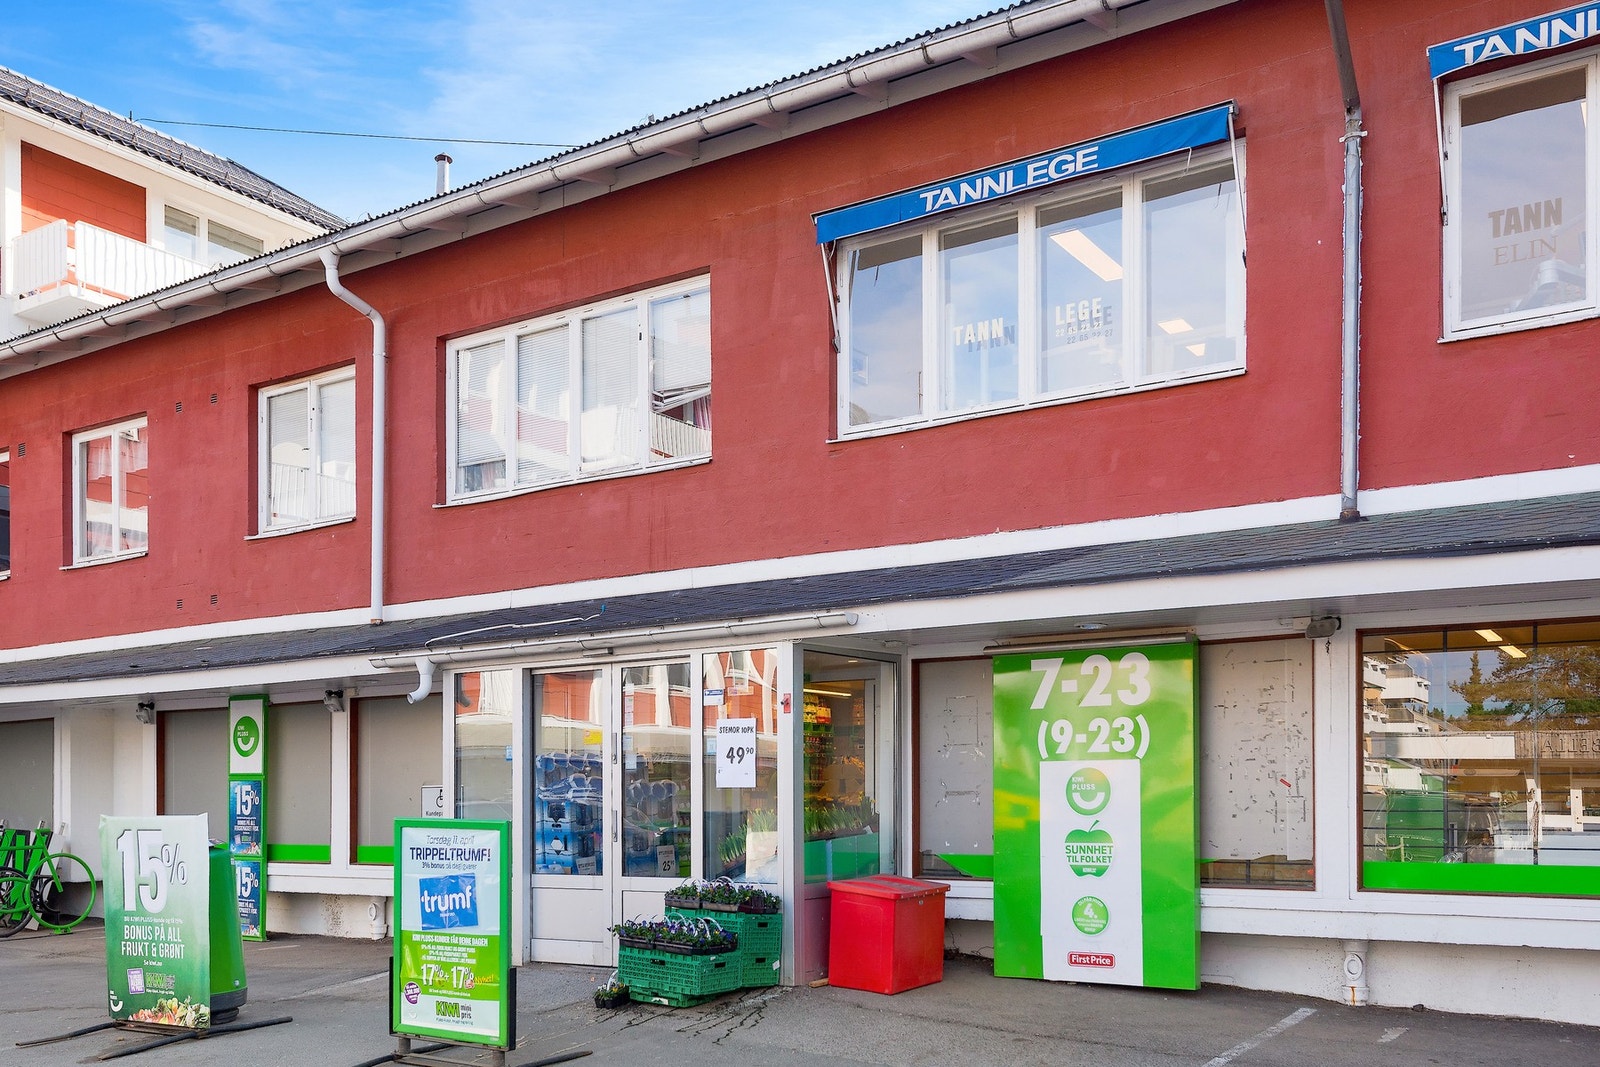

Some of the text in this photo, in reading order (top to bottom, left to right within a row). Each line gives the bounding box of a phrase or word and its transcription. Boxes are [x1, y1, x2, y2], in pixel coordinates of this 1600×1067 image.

[919, 146, 1099, 212] TANNLEGE
[1488, 197, 1562, 239] TANN
[1493, 235, 1559, 266] ELIN
[1056, 298, 1102, 326] LEGE
[953, 318, 1004, 346] TANN
[1030, 652, 1151, 710] 7-23
[719, 726, 740, 734] STEMOR
[1038, 714, 1150, 760] (9-23)
[1072, 783, 1096, 791] PLUSS
[234, 784, 260, 816] 15%
[427, 835, 451, 846] Torsdag
[460, 835, 475, 847] april
[1065, 845, 1114, 855] SUNNHET
[409, 847, 491, 862] TRIPPELTRUMF!
[1067, 855, 1112, 864] TIL FOLKET
[116, 829, 189, 914] 15%
[421, 885, 472, 913] trumf
[124, 923, 182, 942] BONUS PÅ ALL
[121, 941, 185, 960] FRUKT & GRØNT
[1071, 955, 1111, 965] First Price
[421, 963, 444, 986] 17%
[436, 1000, 472, 1018] KIWI mini
[461, 1012, 472, 1020] pris
